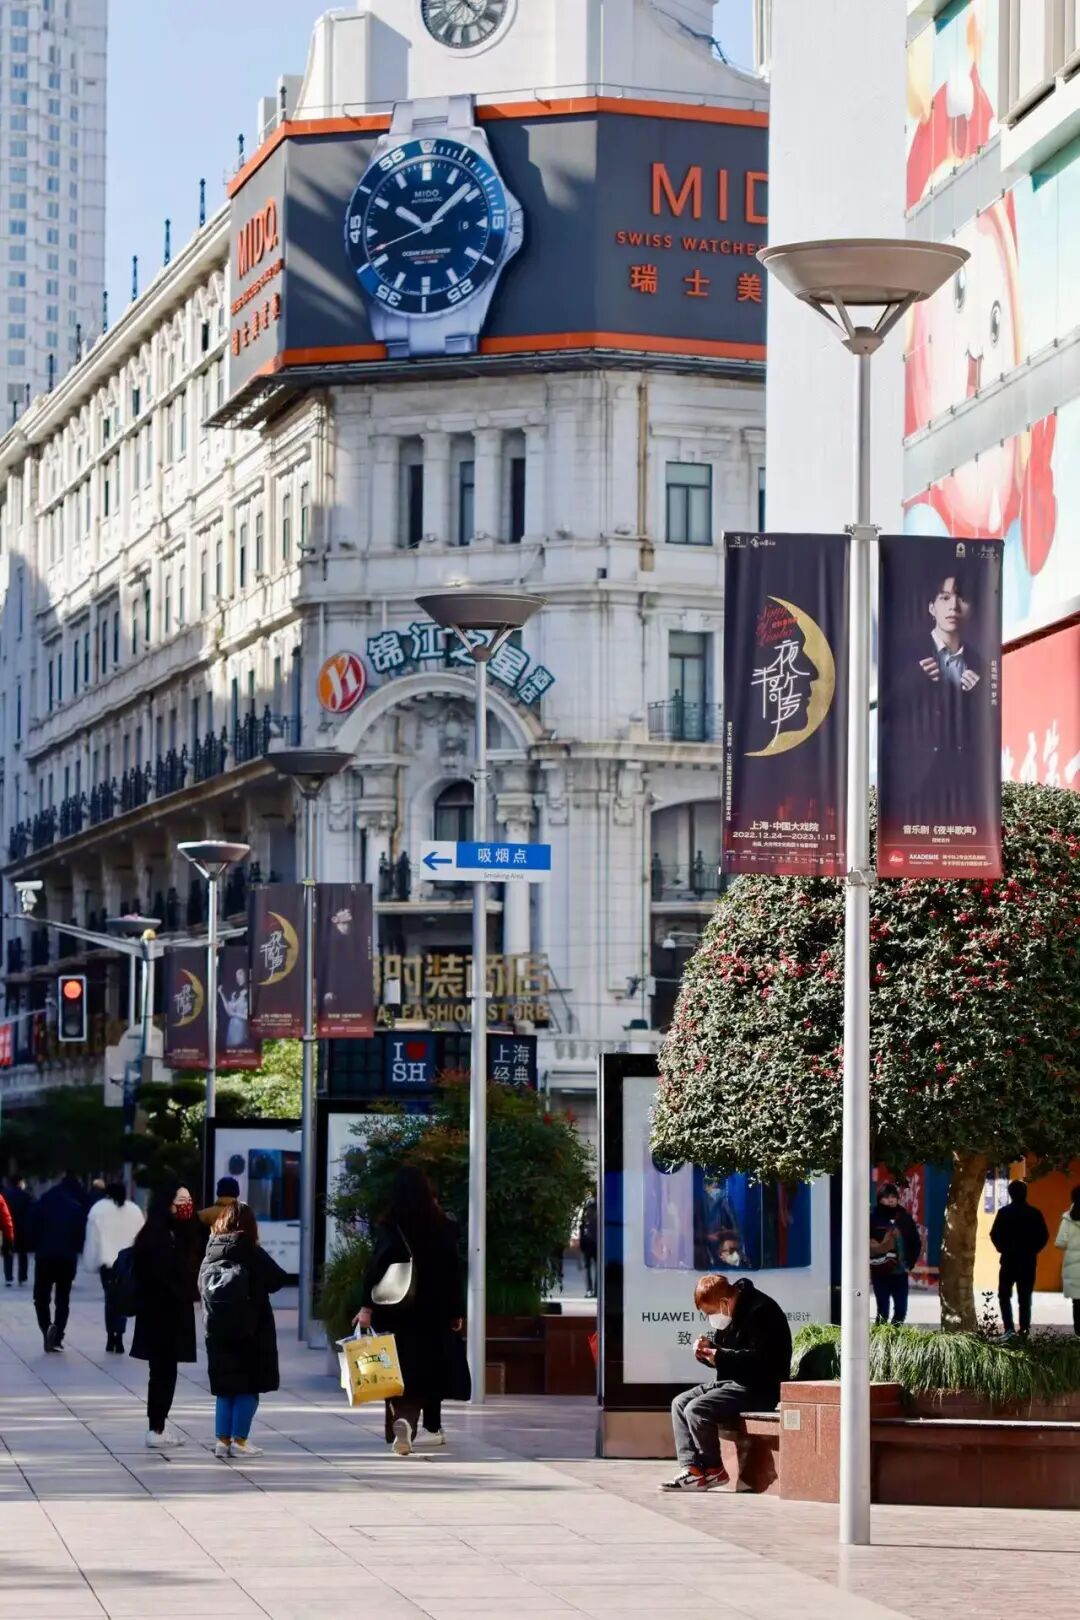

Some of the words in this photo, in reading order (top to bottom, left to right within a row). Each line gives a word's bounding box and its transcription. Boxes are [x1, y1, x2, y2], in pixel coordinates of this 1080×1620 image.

[378, 148, 406, 171] 55
[414, 189, 440, 197] MIDO
[492, 209, 504, 229] 15
[350, 215, 361, 244] 45
[616, 231, 672, 248] SWISS
[376, 284, 402, 307] 35
[447, 278, 474, 303] 25
[477, 848, 528, 864] 吸烟点
[394, 1042, 403, 1061] I
[494, 1044, 531, 1064] 上海
[392, 1062, 427, 1082] SH
[494, 1066, 530, 1086] 经典
[641, 1311, 695, 1322] HUAWEI
